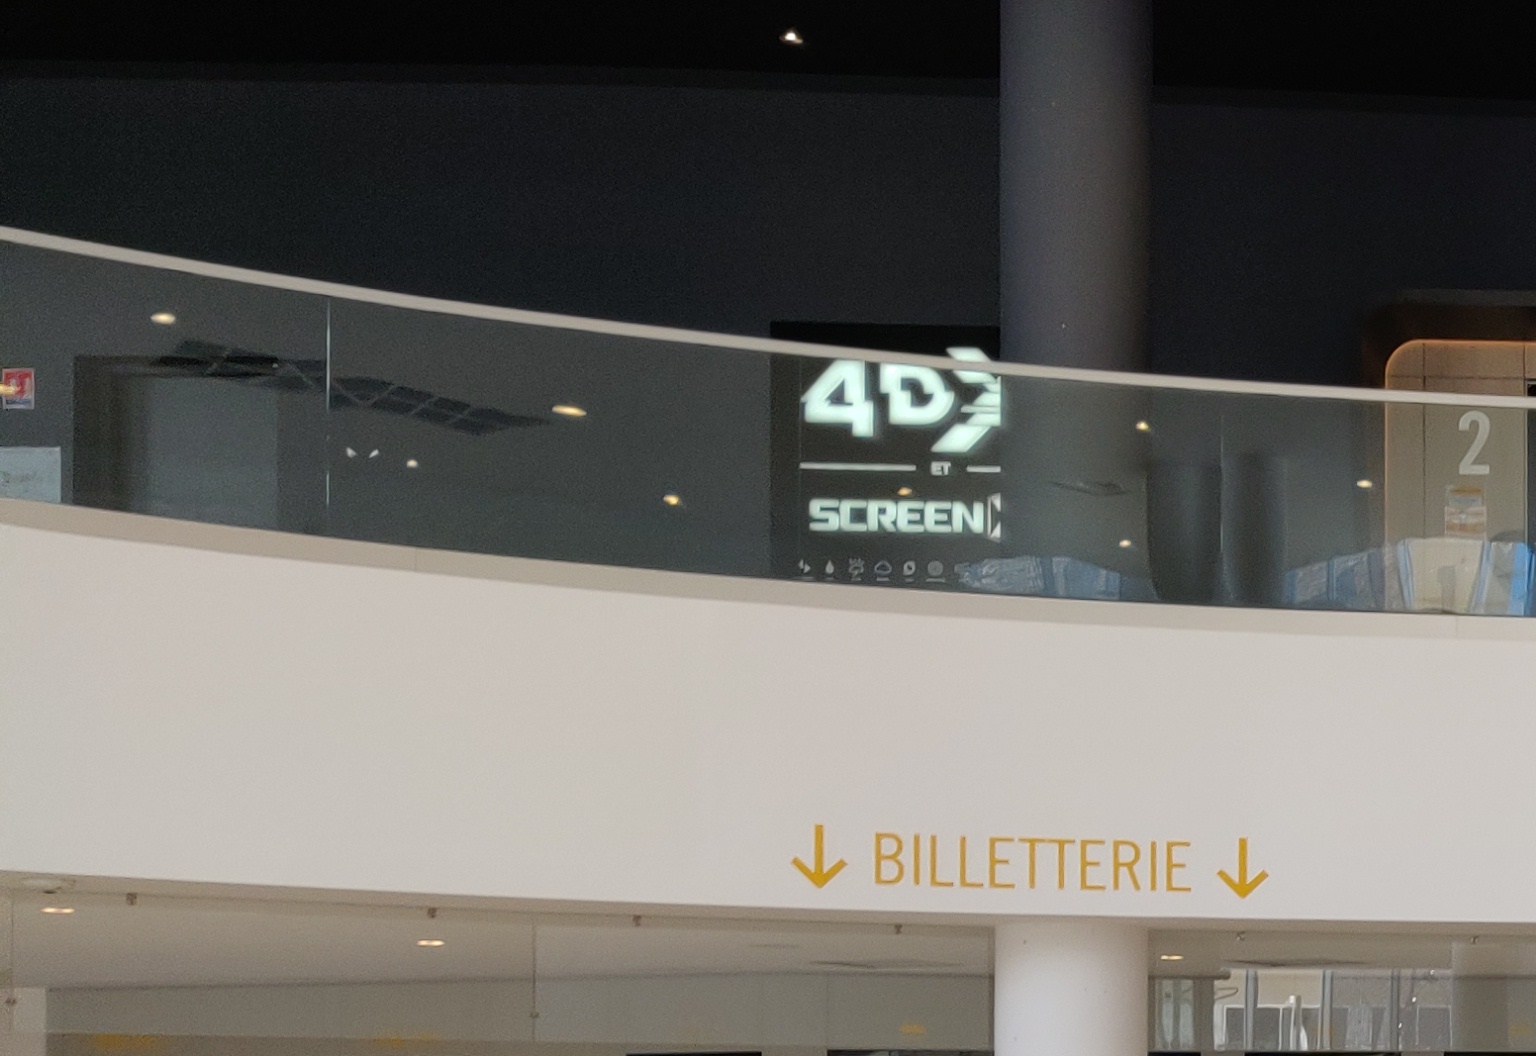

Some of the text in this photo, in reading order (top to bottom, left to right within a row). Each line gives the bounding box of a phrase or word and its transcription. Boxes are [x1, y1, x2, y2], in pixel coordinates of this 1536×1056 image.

[930, 461, 951, 476] ET
[1458, 409, 1491, 475] 2
[873, 831, 1193, 893] BILLETTERIE
